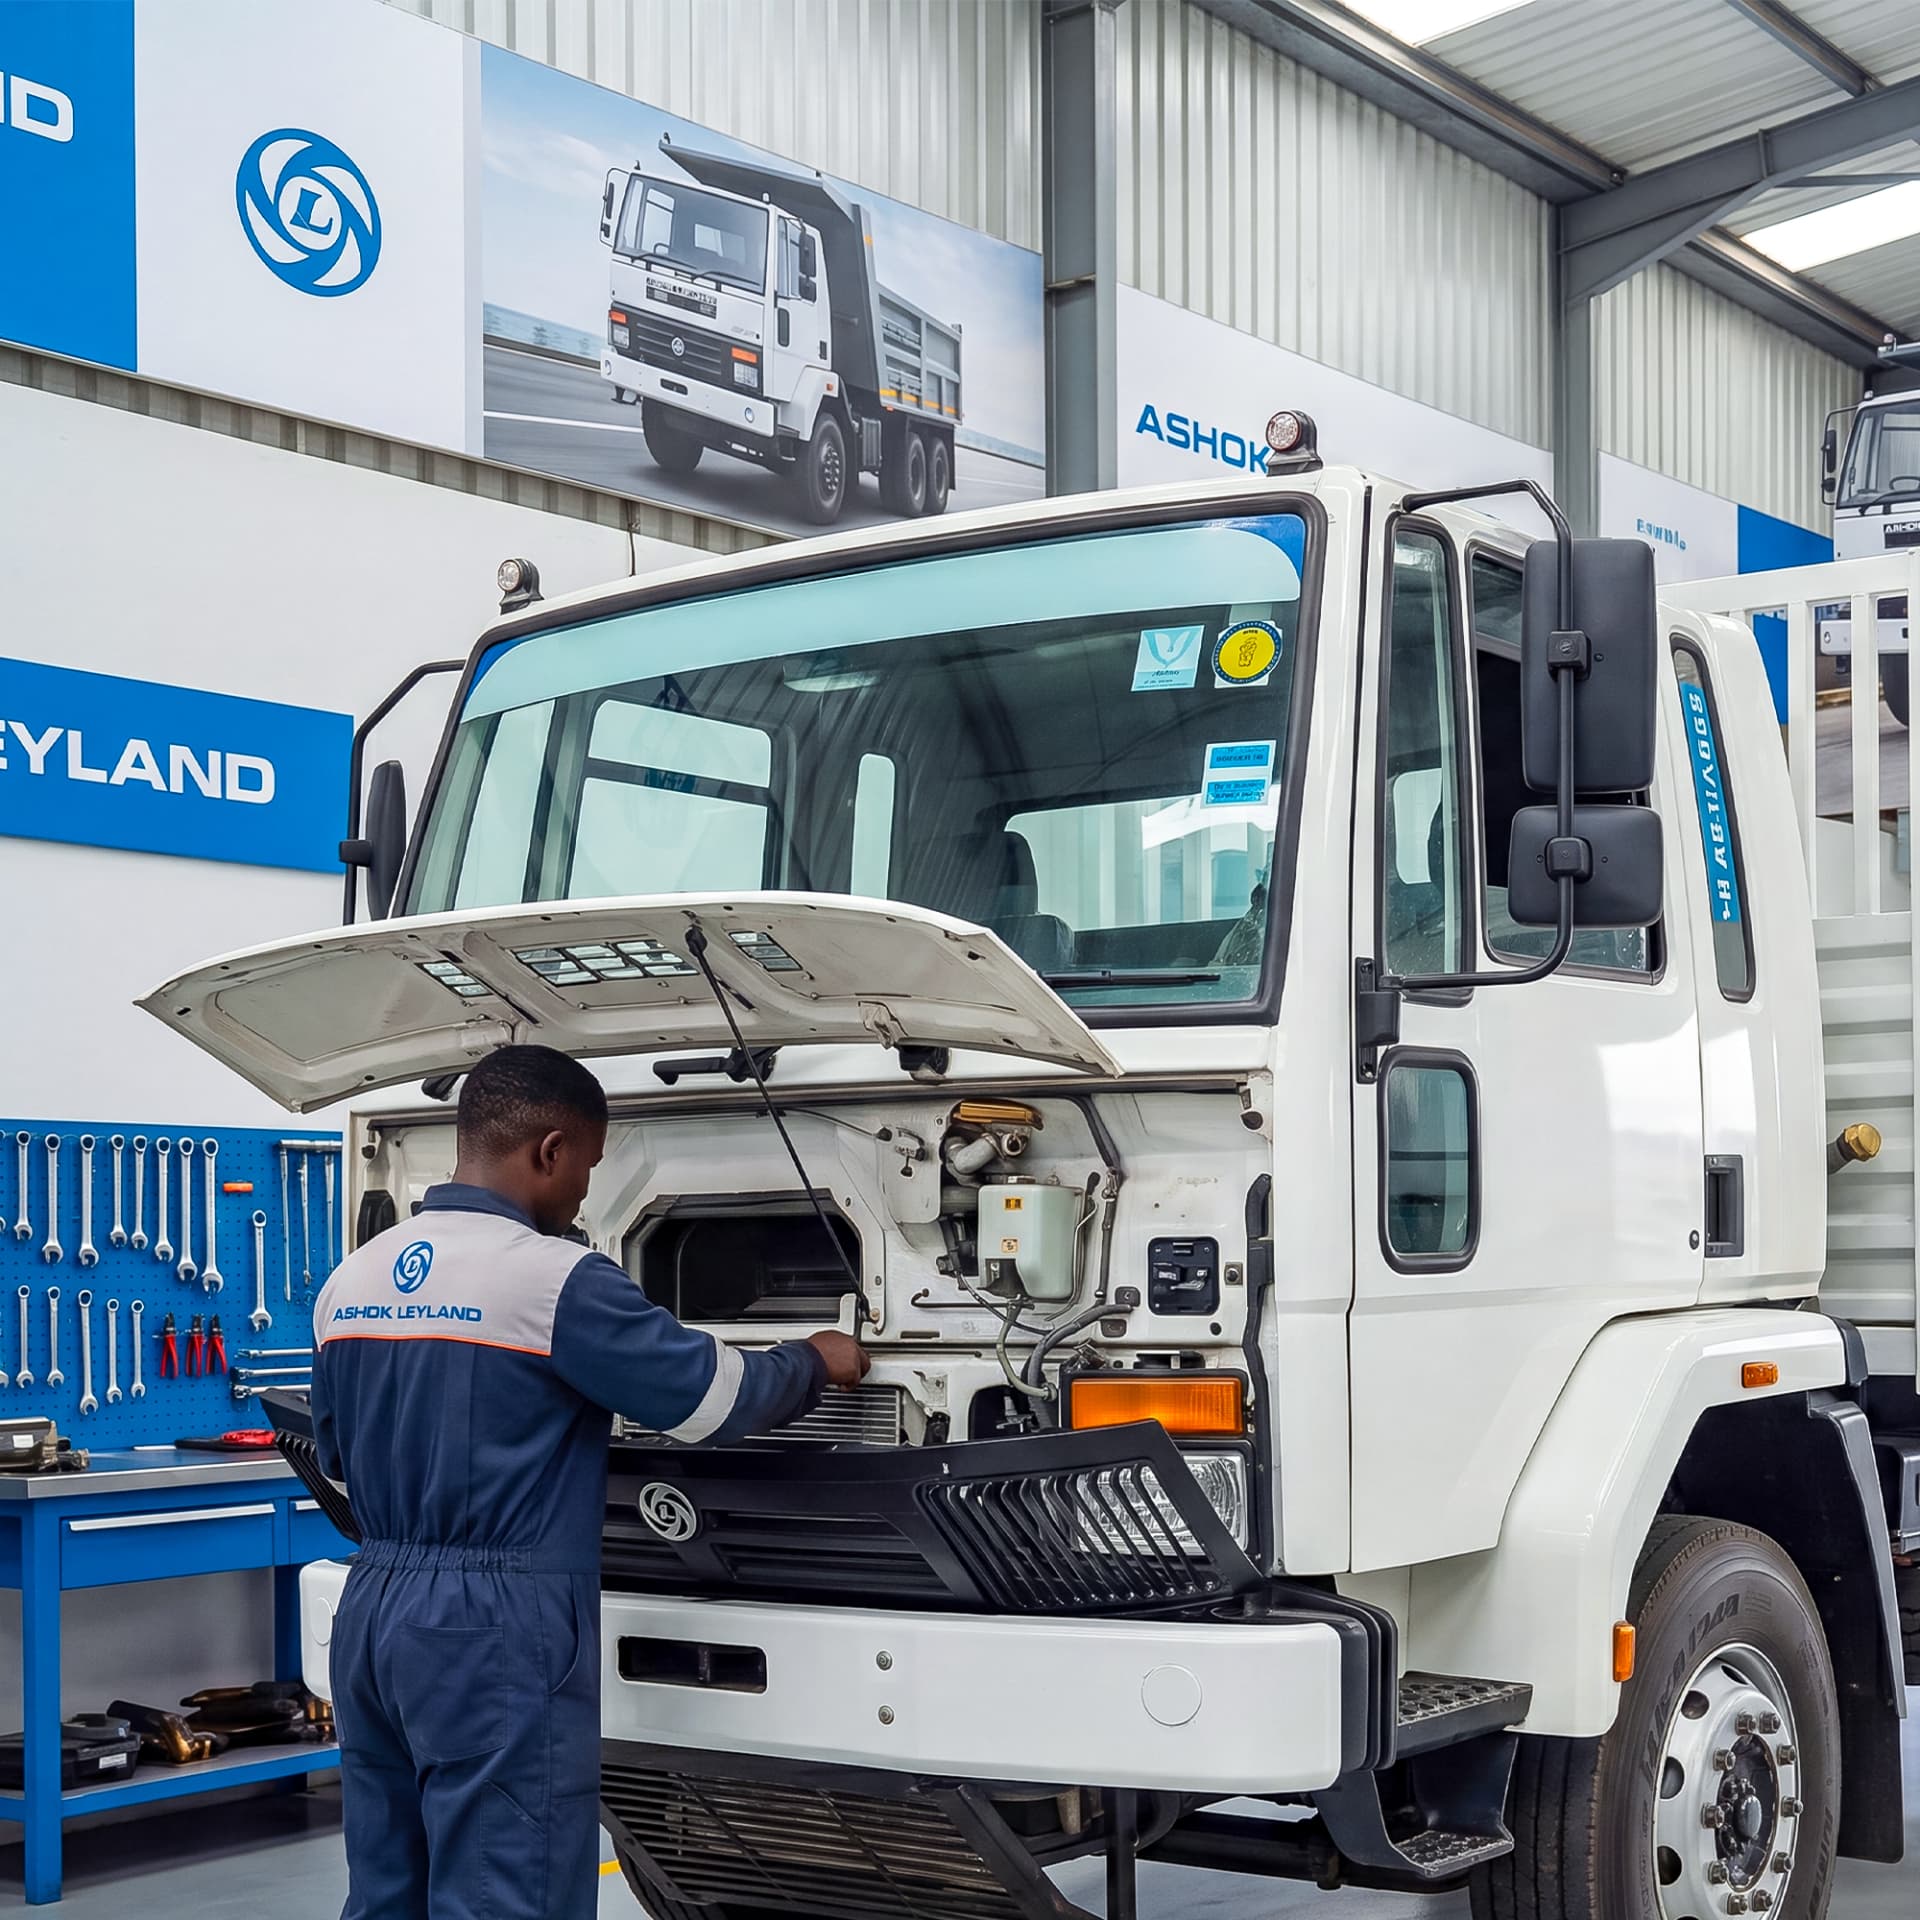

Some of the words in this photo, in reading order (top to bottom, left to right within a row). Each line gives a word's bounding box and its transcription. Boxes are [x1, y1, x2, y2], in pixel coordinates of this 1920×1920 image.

[0, 71, 74, 142] D
[1136, 404, 1270, 473] ASHOK
[0, 720, 275, 804] YLAND
[333, 1306, 392, 1321] ASHOK
[397, 1305, 482, 1322] LEYLAND
